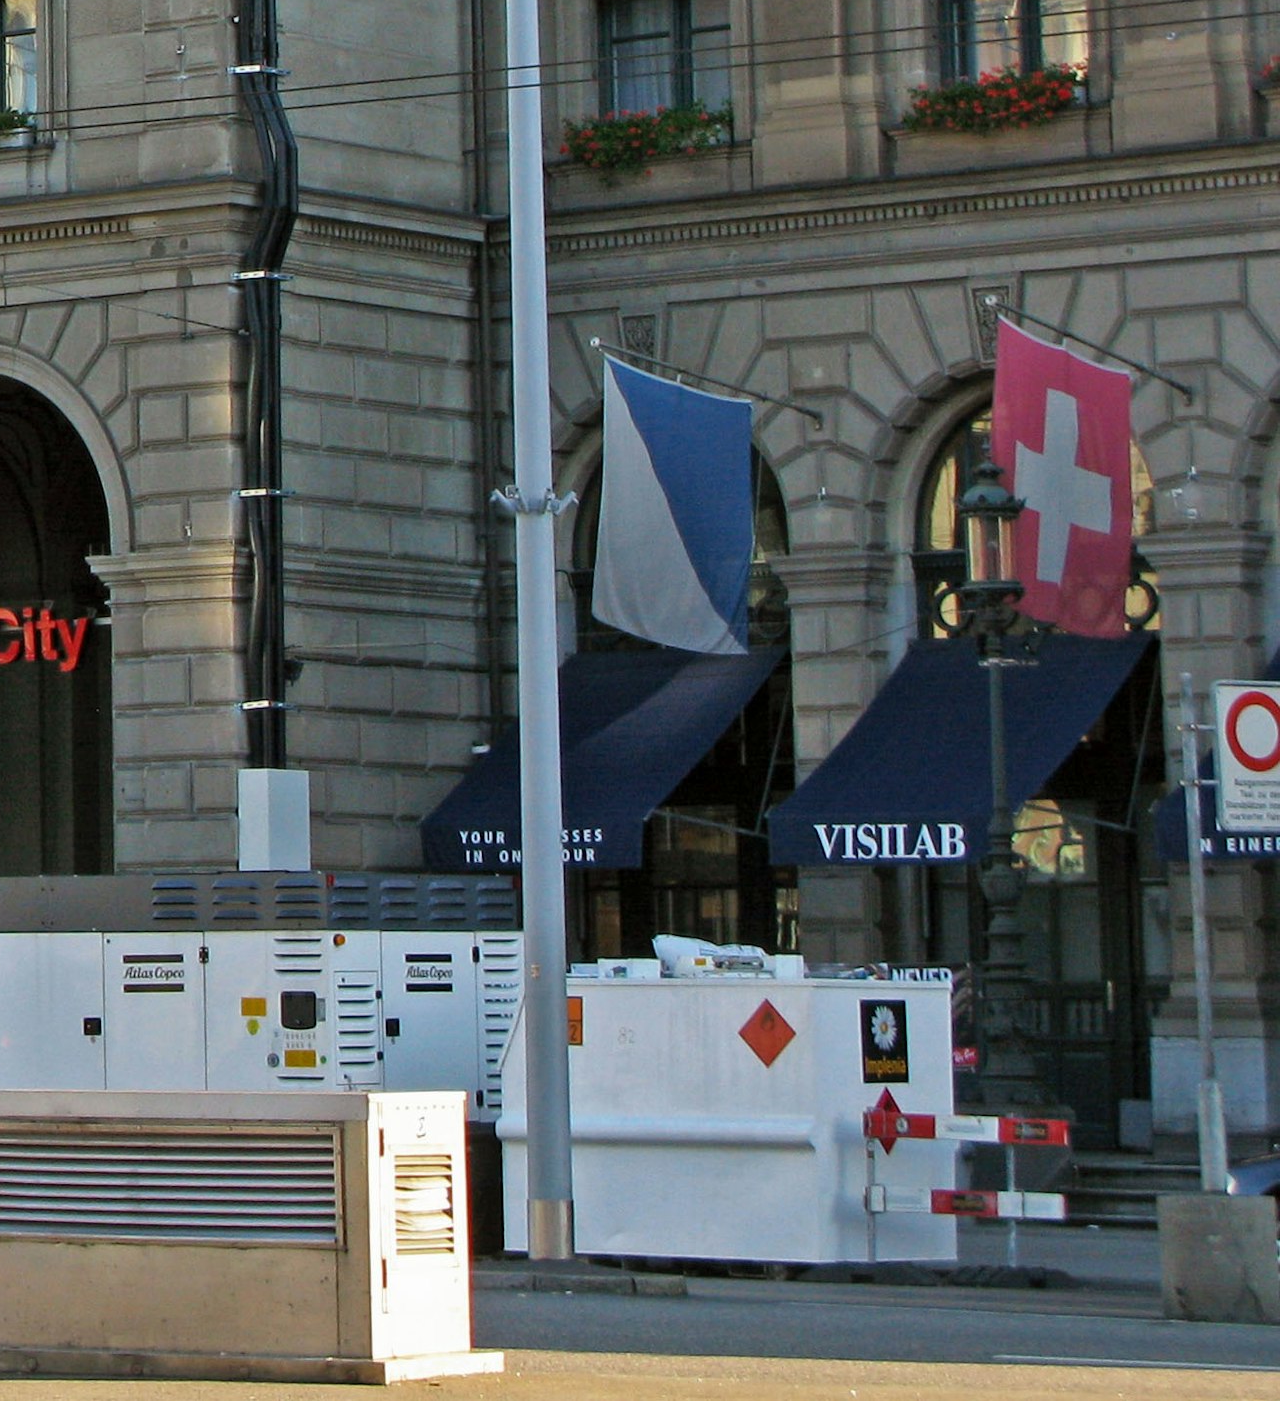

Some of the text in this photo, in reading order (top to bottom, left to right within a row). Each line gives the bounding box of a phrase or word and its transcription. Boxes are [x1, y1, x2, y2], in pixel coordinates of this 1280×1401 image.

[459, 828, 604, 844] YOUR SSES
[813, 823, 966, 860] VISILAB
[465, 848, 596, 863] IN ON OUR
[124, 966, 185, 981] Atlas Copco
